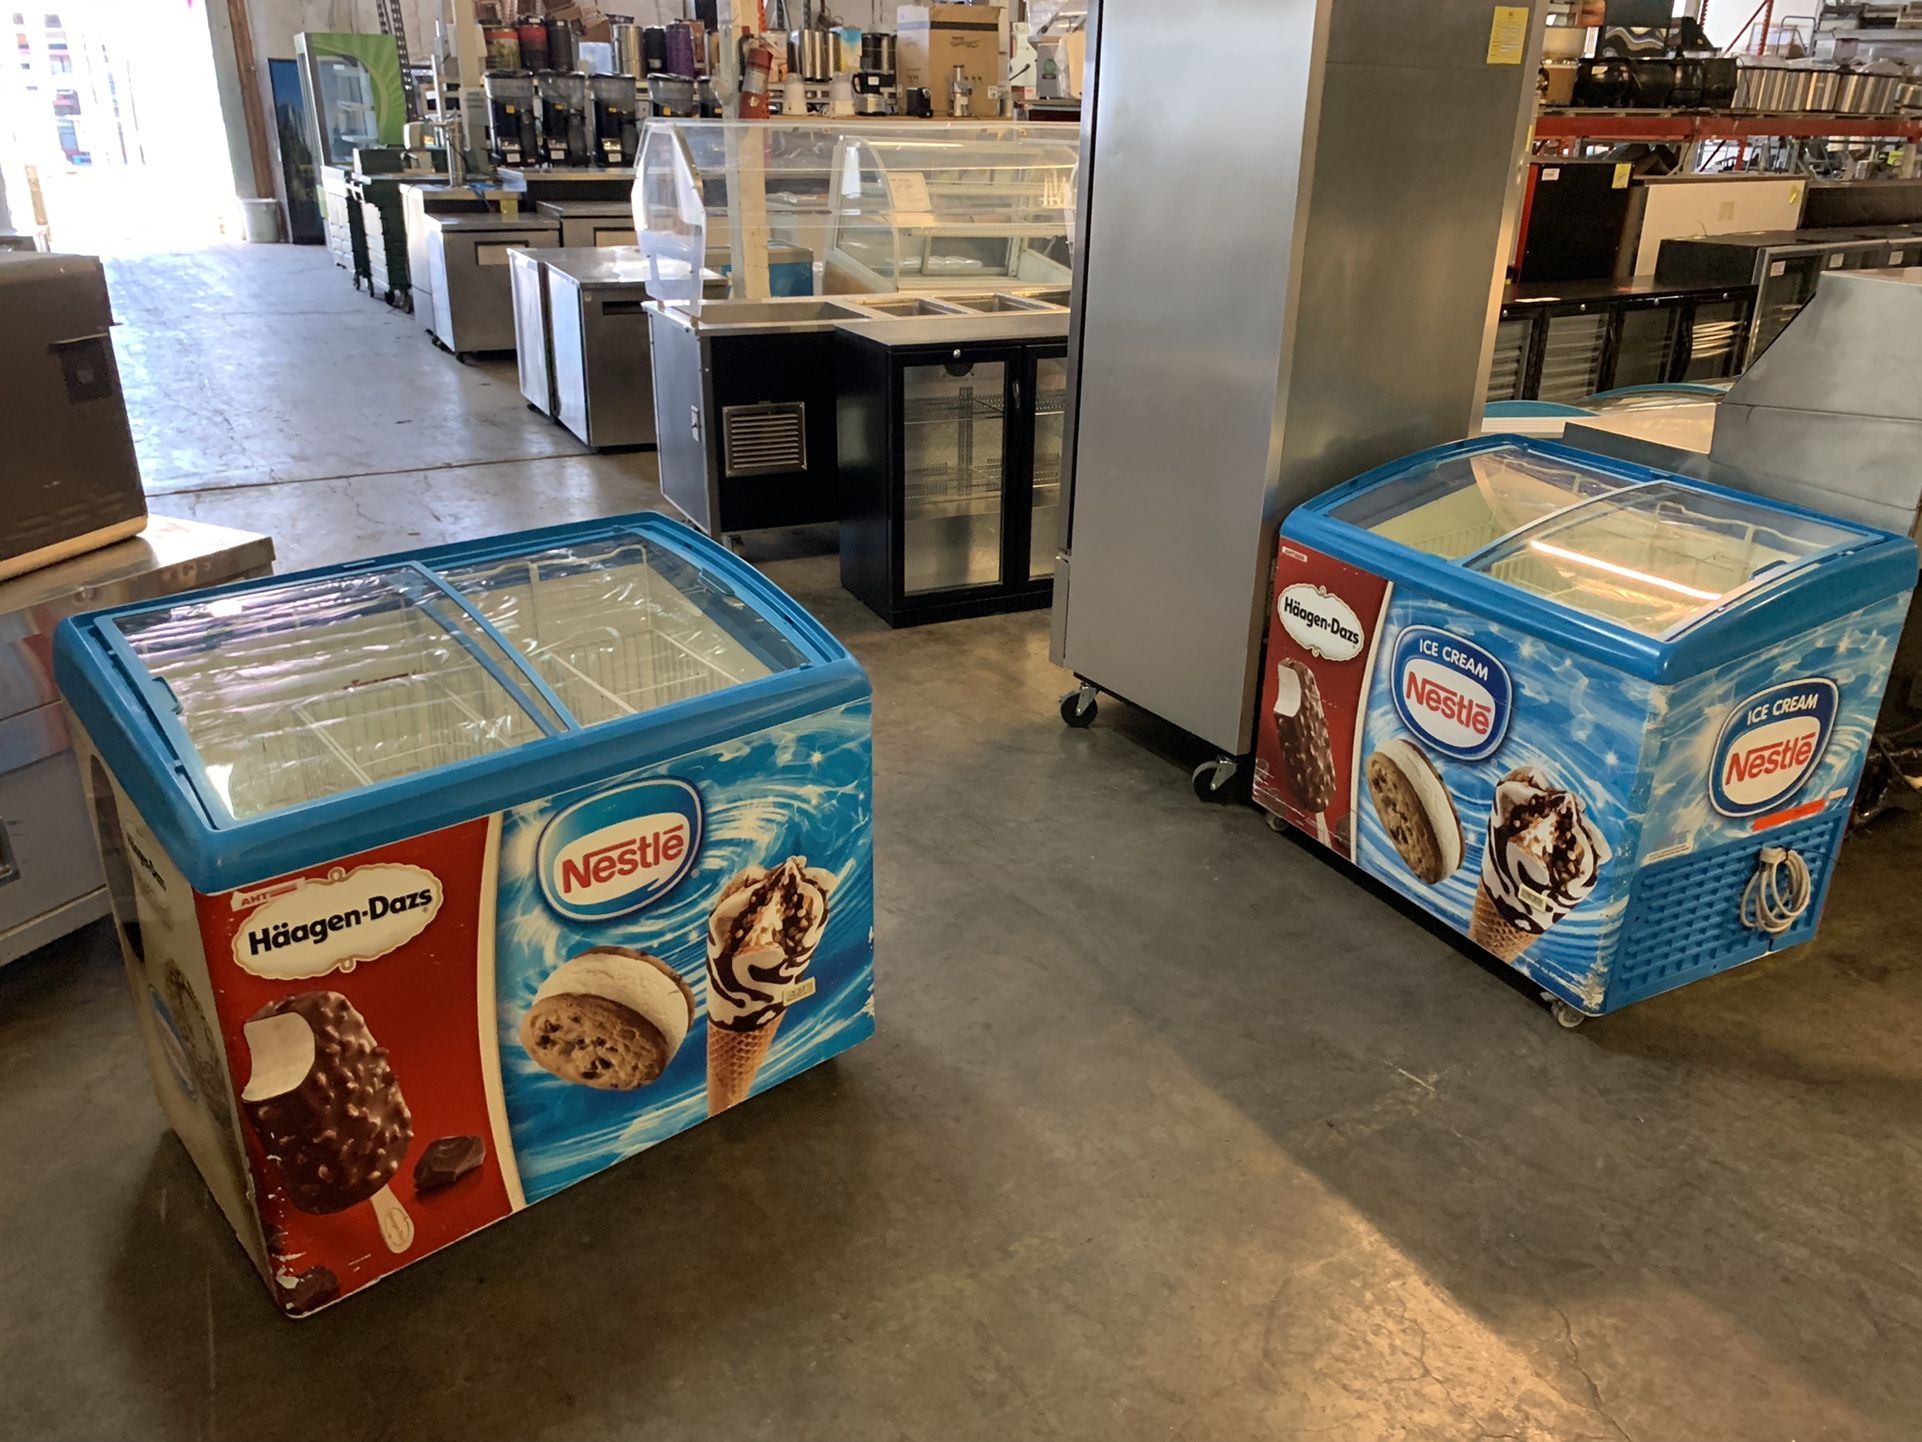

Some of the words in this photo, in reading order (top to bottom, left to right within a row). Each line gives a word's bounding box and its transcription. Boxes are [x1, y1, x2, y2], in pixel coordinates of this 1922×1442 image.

[1284, 596, 1360, 645] Häagen-Dazs
[1420, 638, 1439, 657] ICE
[1442, 646, 1489, 681] CREAM
[1406, 671, 1492, 735] Nestlé
[1747, 704, 1770, 726] ICE
[1772, 693, 1819, 716] CREAM
[1725, 731, 1816, 786] Nestlé
[562, 824, 684, 894] Nestlé
[248, 888, 433, 956] Häagen-Dazs
